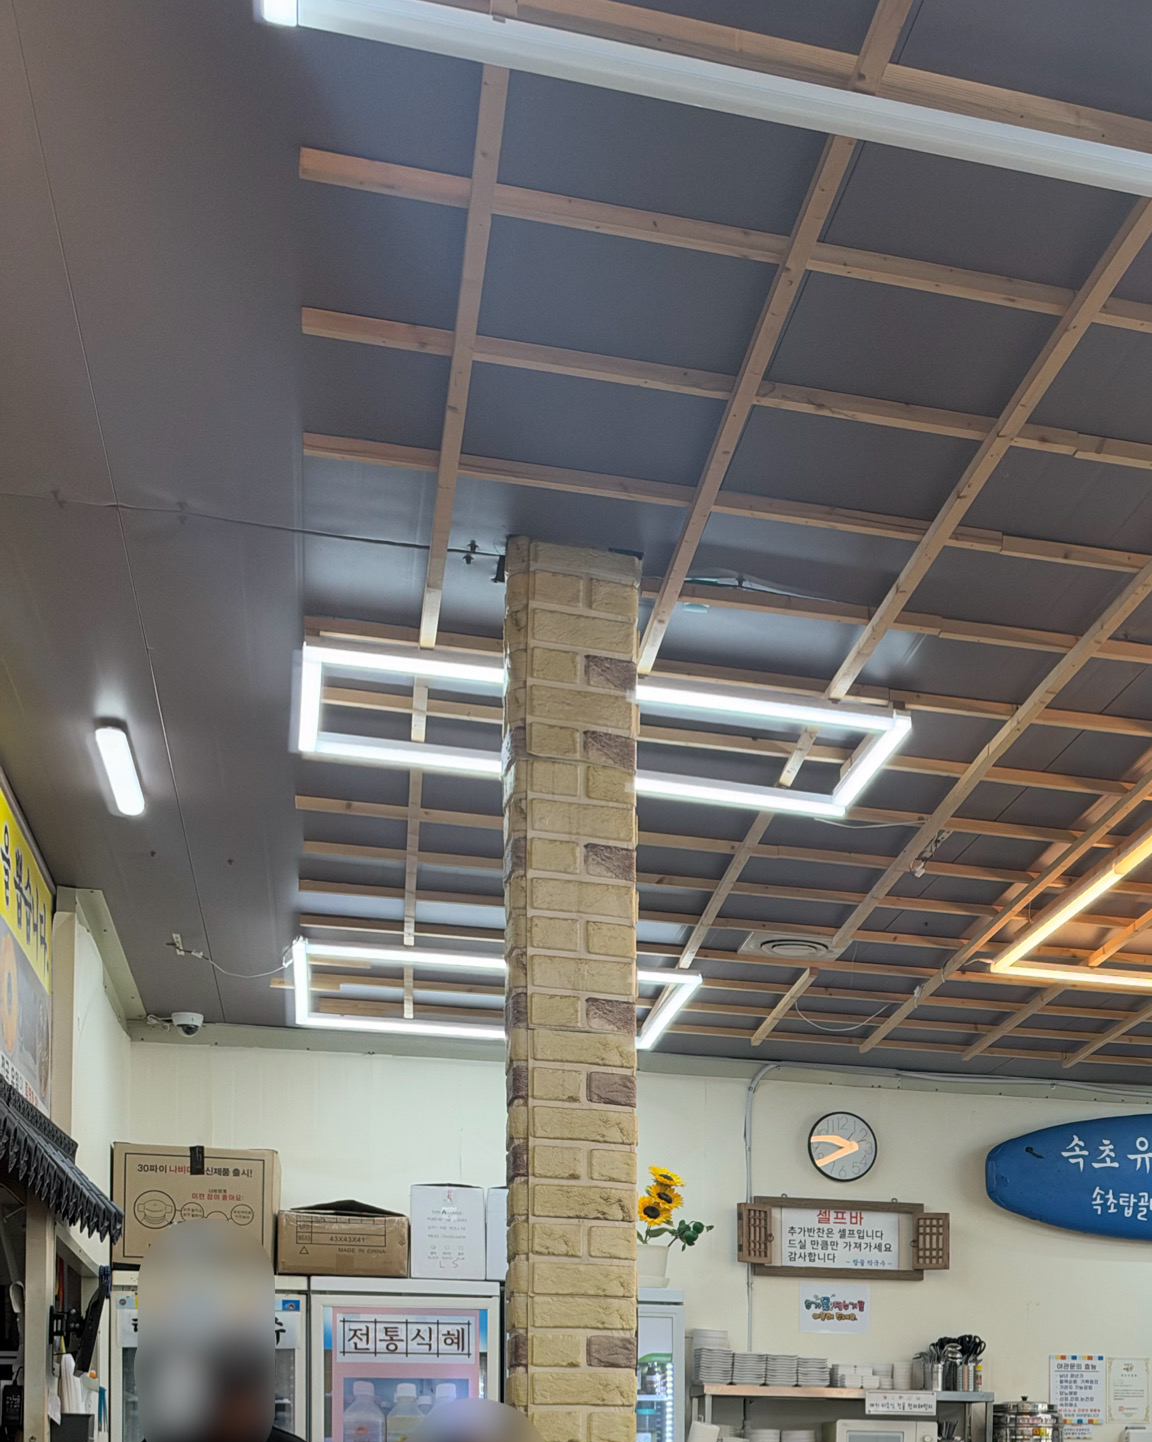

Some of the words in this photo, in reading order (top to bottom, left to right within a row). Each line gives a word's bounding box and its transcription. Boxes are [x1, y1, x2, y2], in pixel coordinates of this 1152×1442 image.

[838, 1116, 849, 1130] 12
[859, 1128, 868, 1142] 2
[1060, 1134, 1120, 1173] 속초
[860, 1154, 868, 1168] 4
[137, 1164, 167, 1173] 30파이
[205, 1167, 229, 1176] 신제품
[232, 1168, 253, 1177] 출시!
[839, 1165, 847, 1178] 6
[852, 1162, 860, 1175] 5
[816, 1209, 864, 1226] 셀프바
[329, 1235, 366, 1243] 43X43X41
[787, 1226, 835, 1238] 추가반찬은
[837, 1228, 884, 1240] 셀프입니다
[787, 1239, 807, 1250] 드실
[810, 1239, 839, 1251] 만큼만
[842, 1241, 892, 1252] 가져가세요
[787, 1251, 836, 1263] 감사합니다
[347, 1325, 465, 1353] 전통식혜
